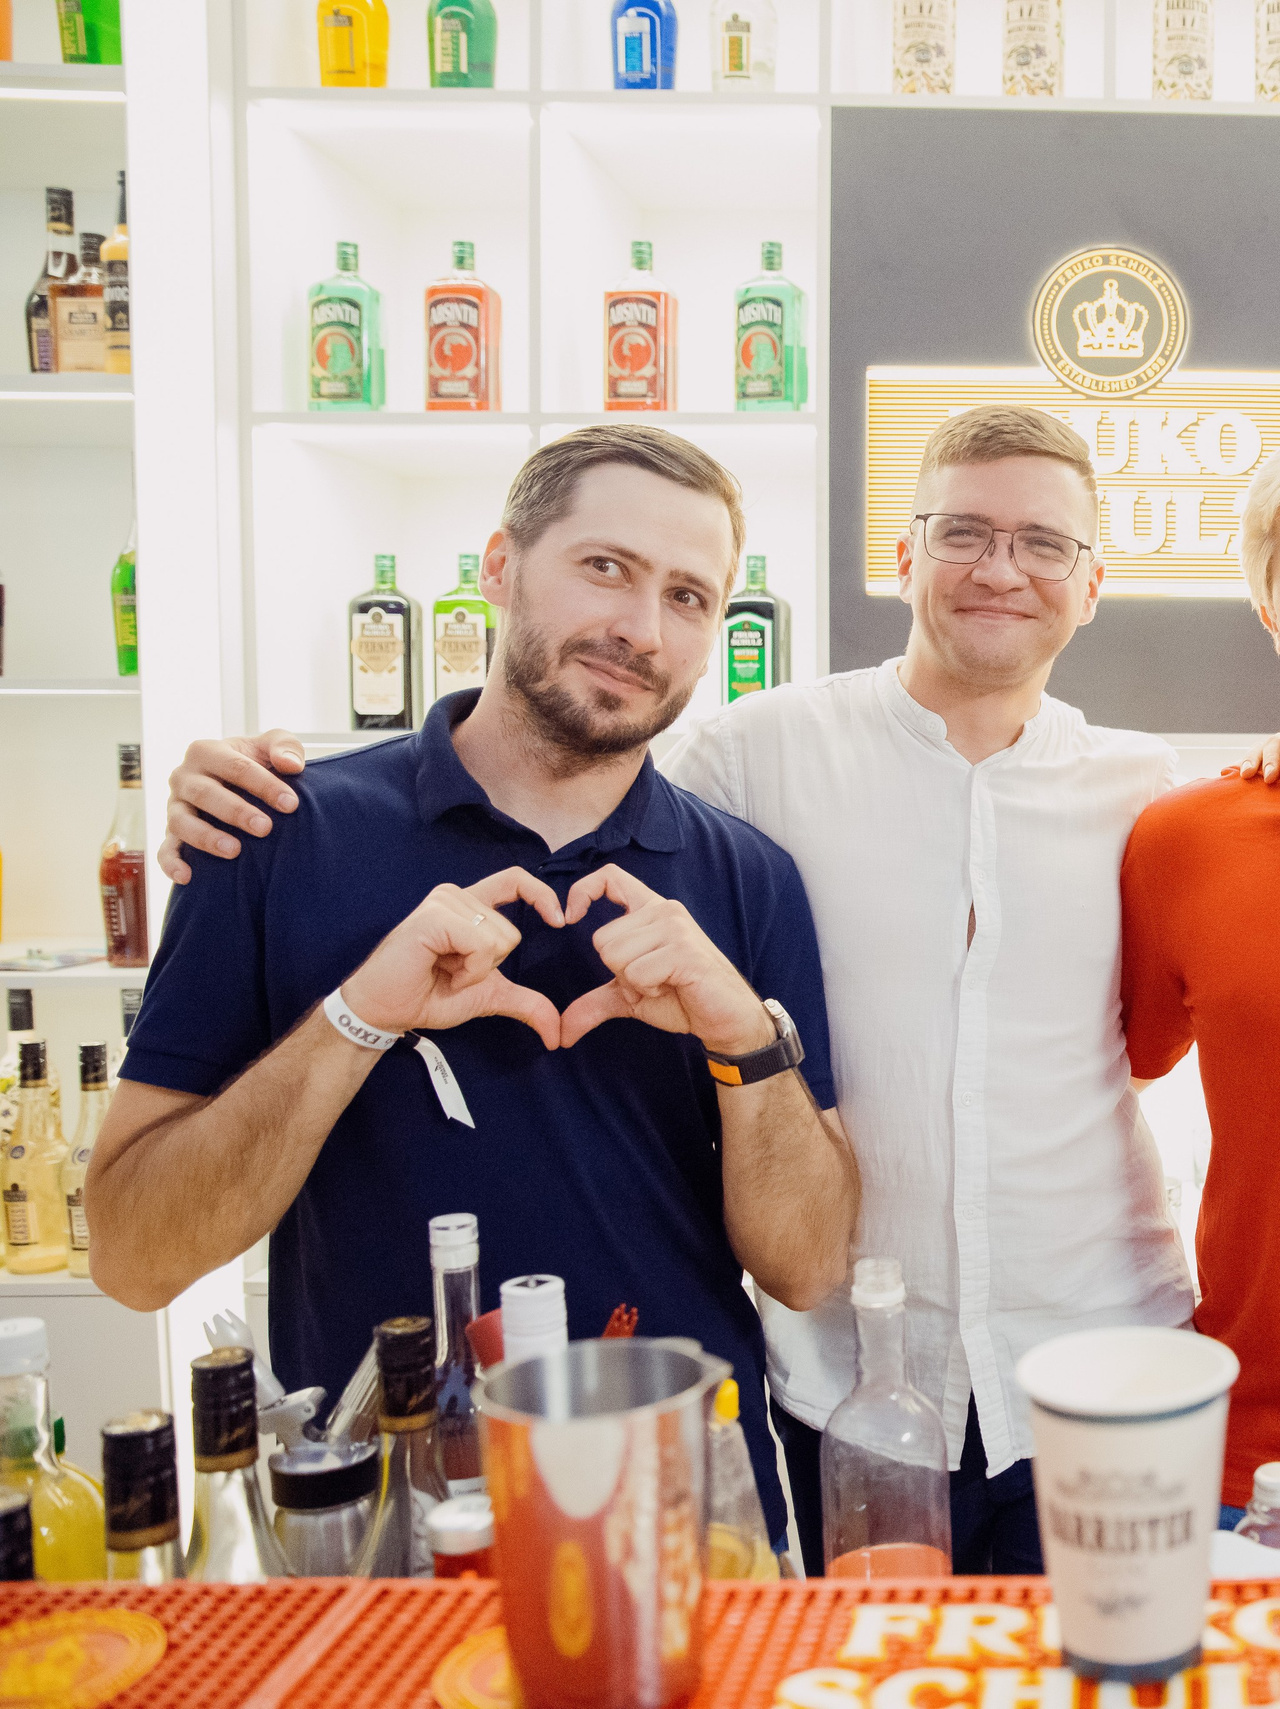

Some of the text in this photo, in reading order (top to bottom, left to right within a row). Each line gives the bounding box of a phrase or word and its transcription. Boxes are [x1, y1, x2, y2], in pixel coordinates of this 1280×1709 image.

[1057, 255, 1166, 288] FRUKO SCHULZ
[1056, 359, 1137, 392] ESTABLISHED
[359, 641, 397, 653] FERNET
[442, 641, 480, 653] FERNET
[338, 1013, 381, 1045] EXPO
